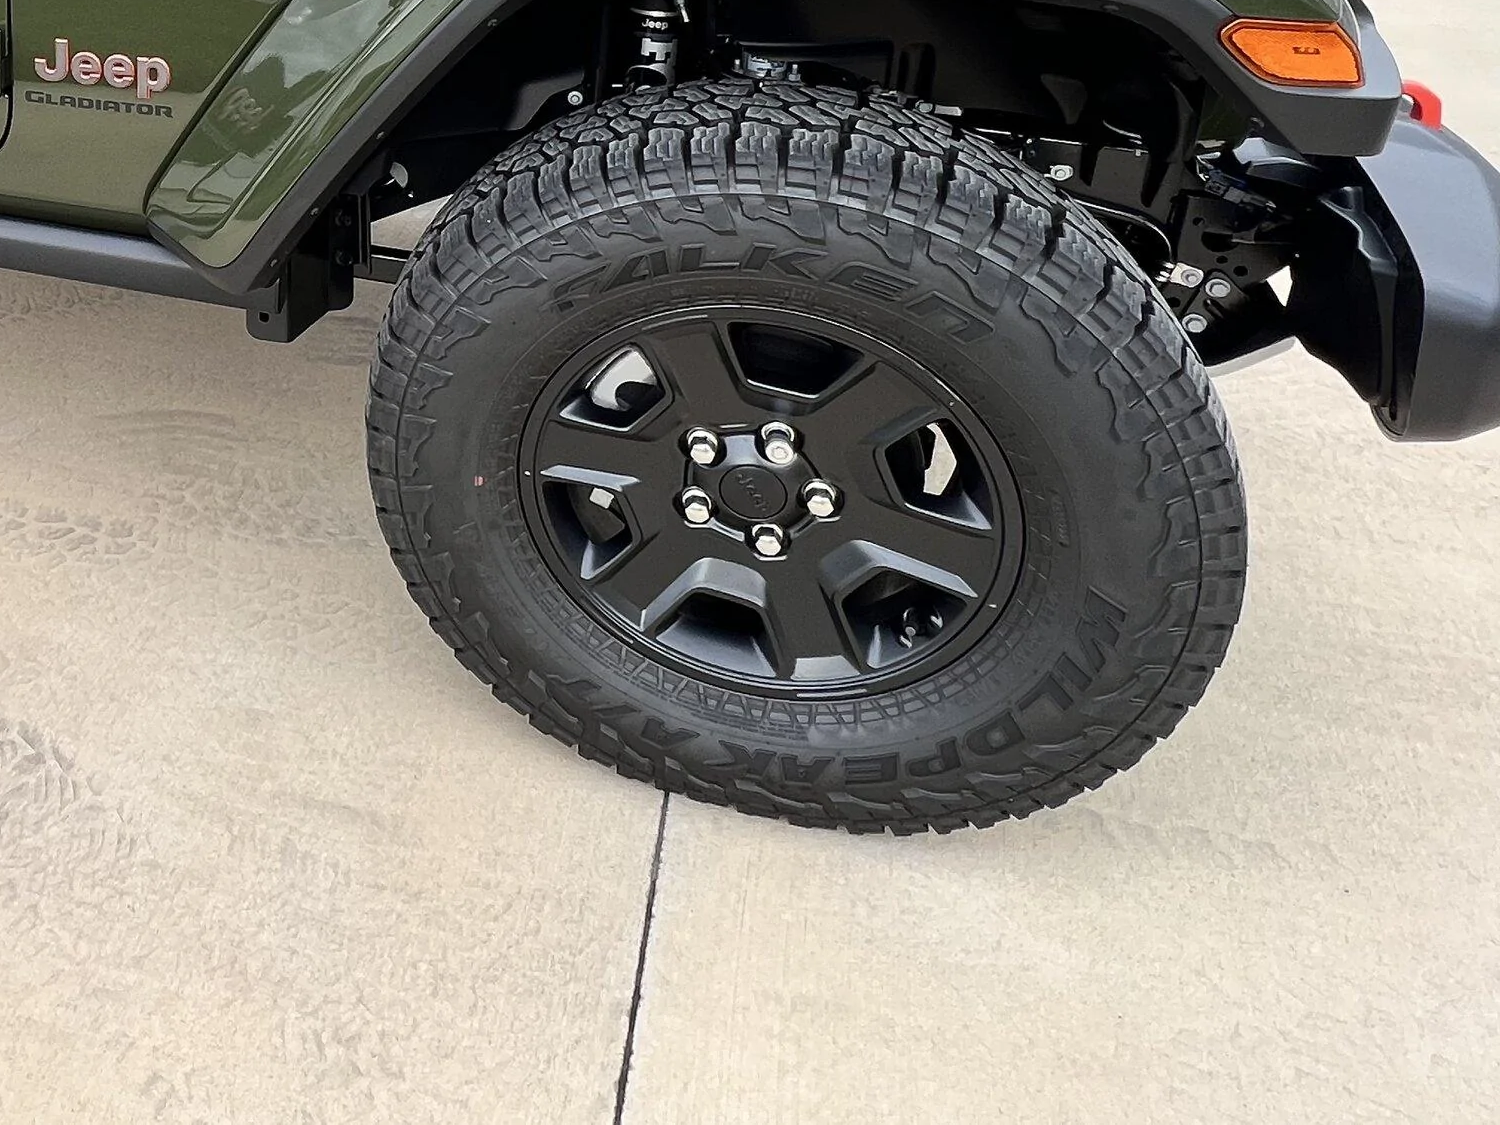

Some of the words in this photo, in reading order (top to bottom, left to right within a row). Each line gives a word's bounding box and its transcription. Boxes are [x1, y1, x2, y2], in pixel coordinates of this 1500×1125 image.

[641, 18, 669, 31] Jeep
[33, 37, 171, 100] Jeep
[24, 90, 174, 119] GLADIATOR
[538, 242, 996, 345] FALKEN
[702, 585, 1129, 785] WILDPEAK
